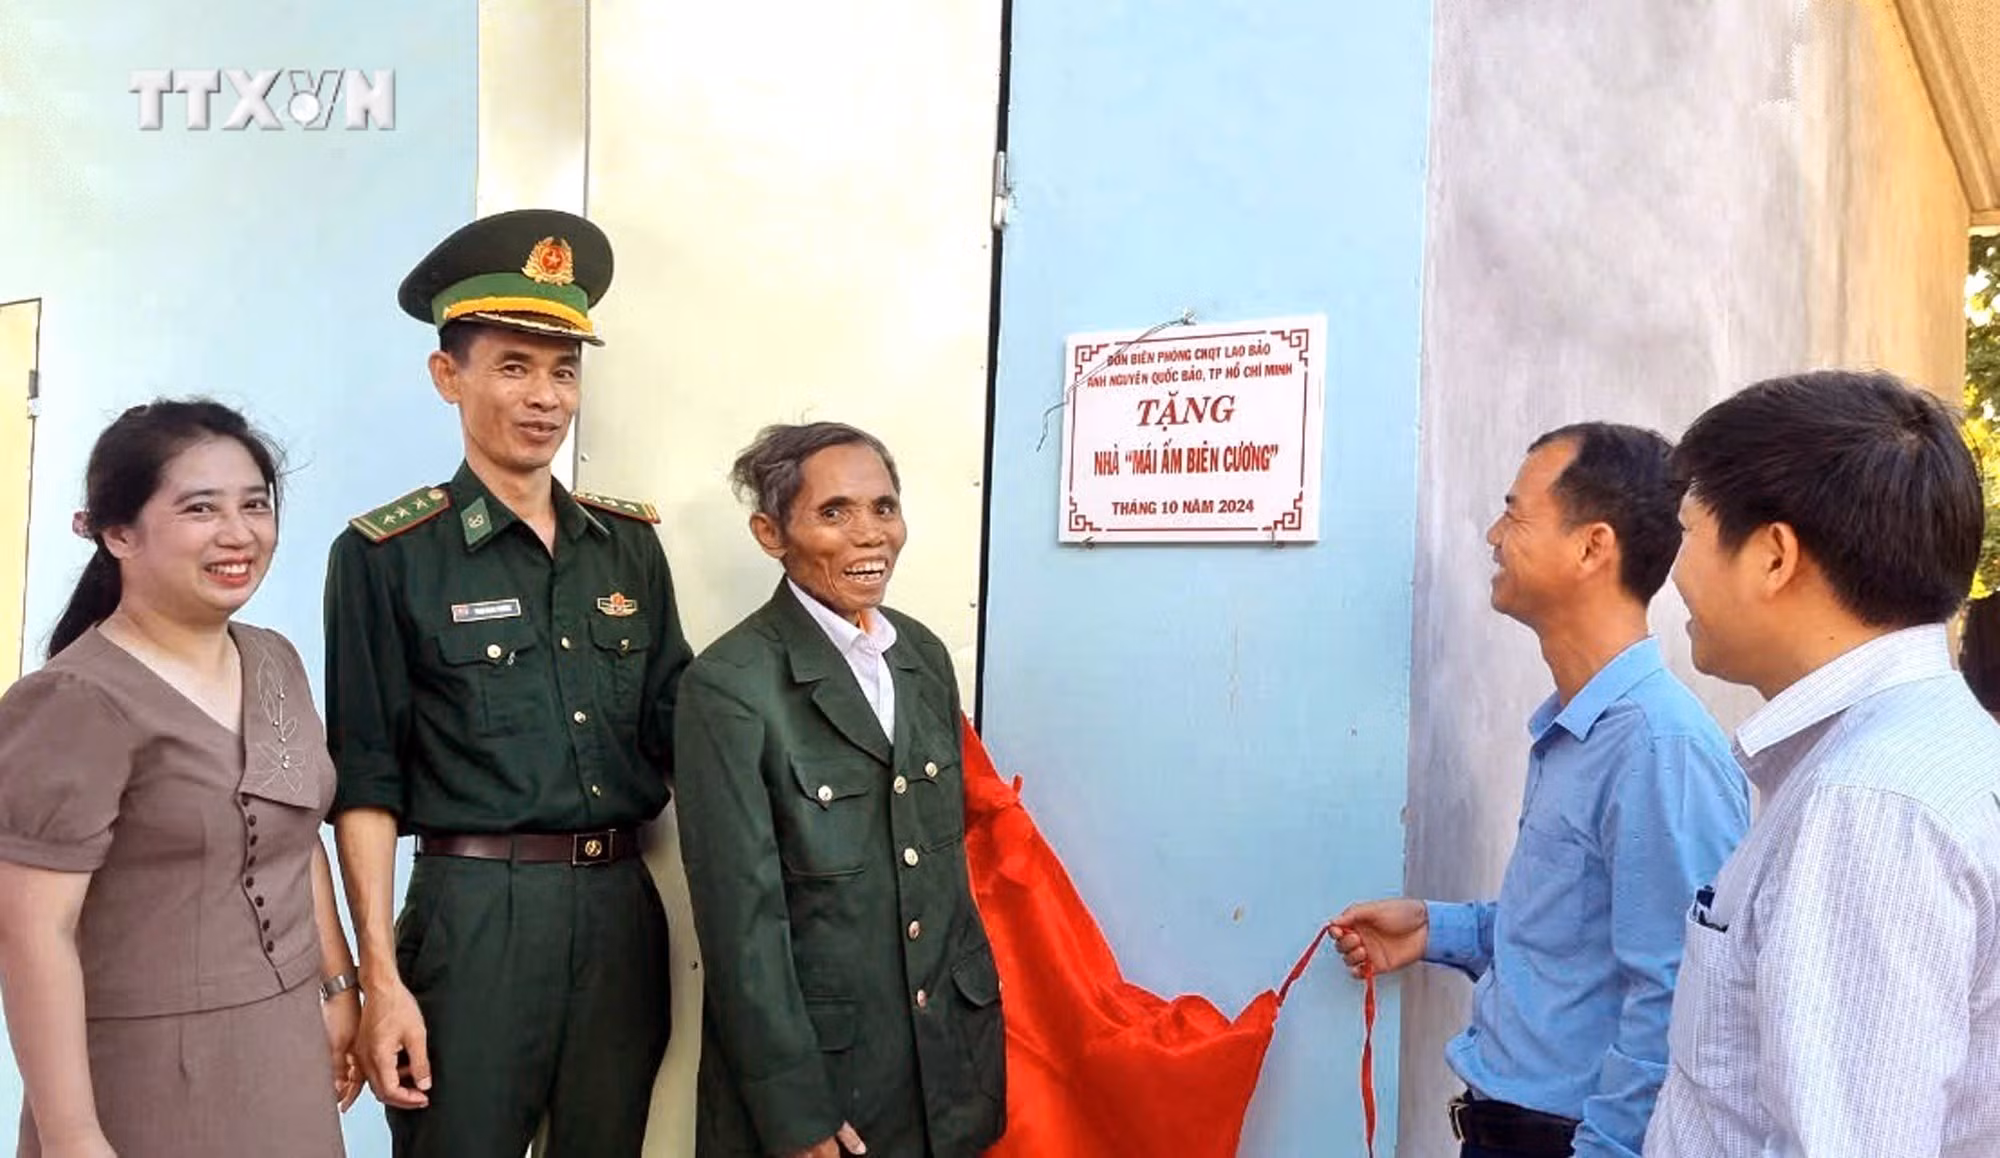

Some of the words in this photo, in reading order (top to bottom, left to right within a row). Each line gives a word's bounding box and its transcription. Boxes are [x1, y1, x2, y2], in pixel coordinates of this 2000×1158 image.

[1225, 345, 1245, 358] LAO
[1248, 339, 1271, 356] BẢO
[1208, 367, 1222, 380] TP
[1264, 362, 1293, 377] MINH
[1137, 391, 1236, 432] TẶNG
[1094, 444, 1120, 476] NHÀ
[1160, 438, 1183, 474] ẤM
[1186, 440, 1219, 473] BIÊN
[1112, 499, 1157, 515] THÁNG
[1161, 501, 1178, 514] 10
[1182, 498, 1214, 513] NĂM
[1218, 499, 1255, 513] 2024
